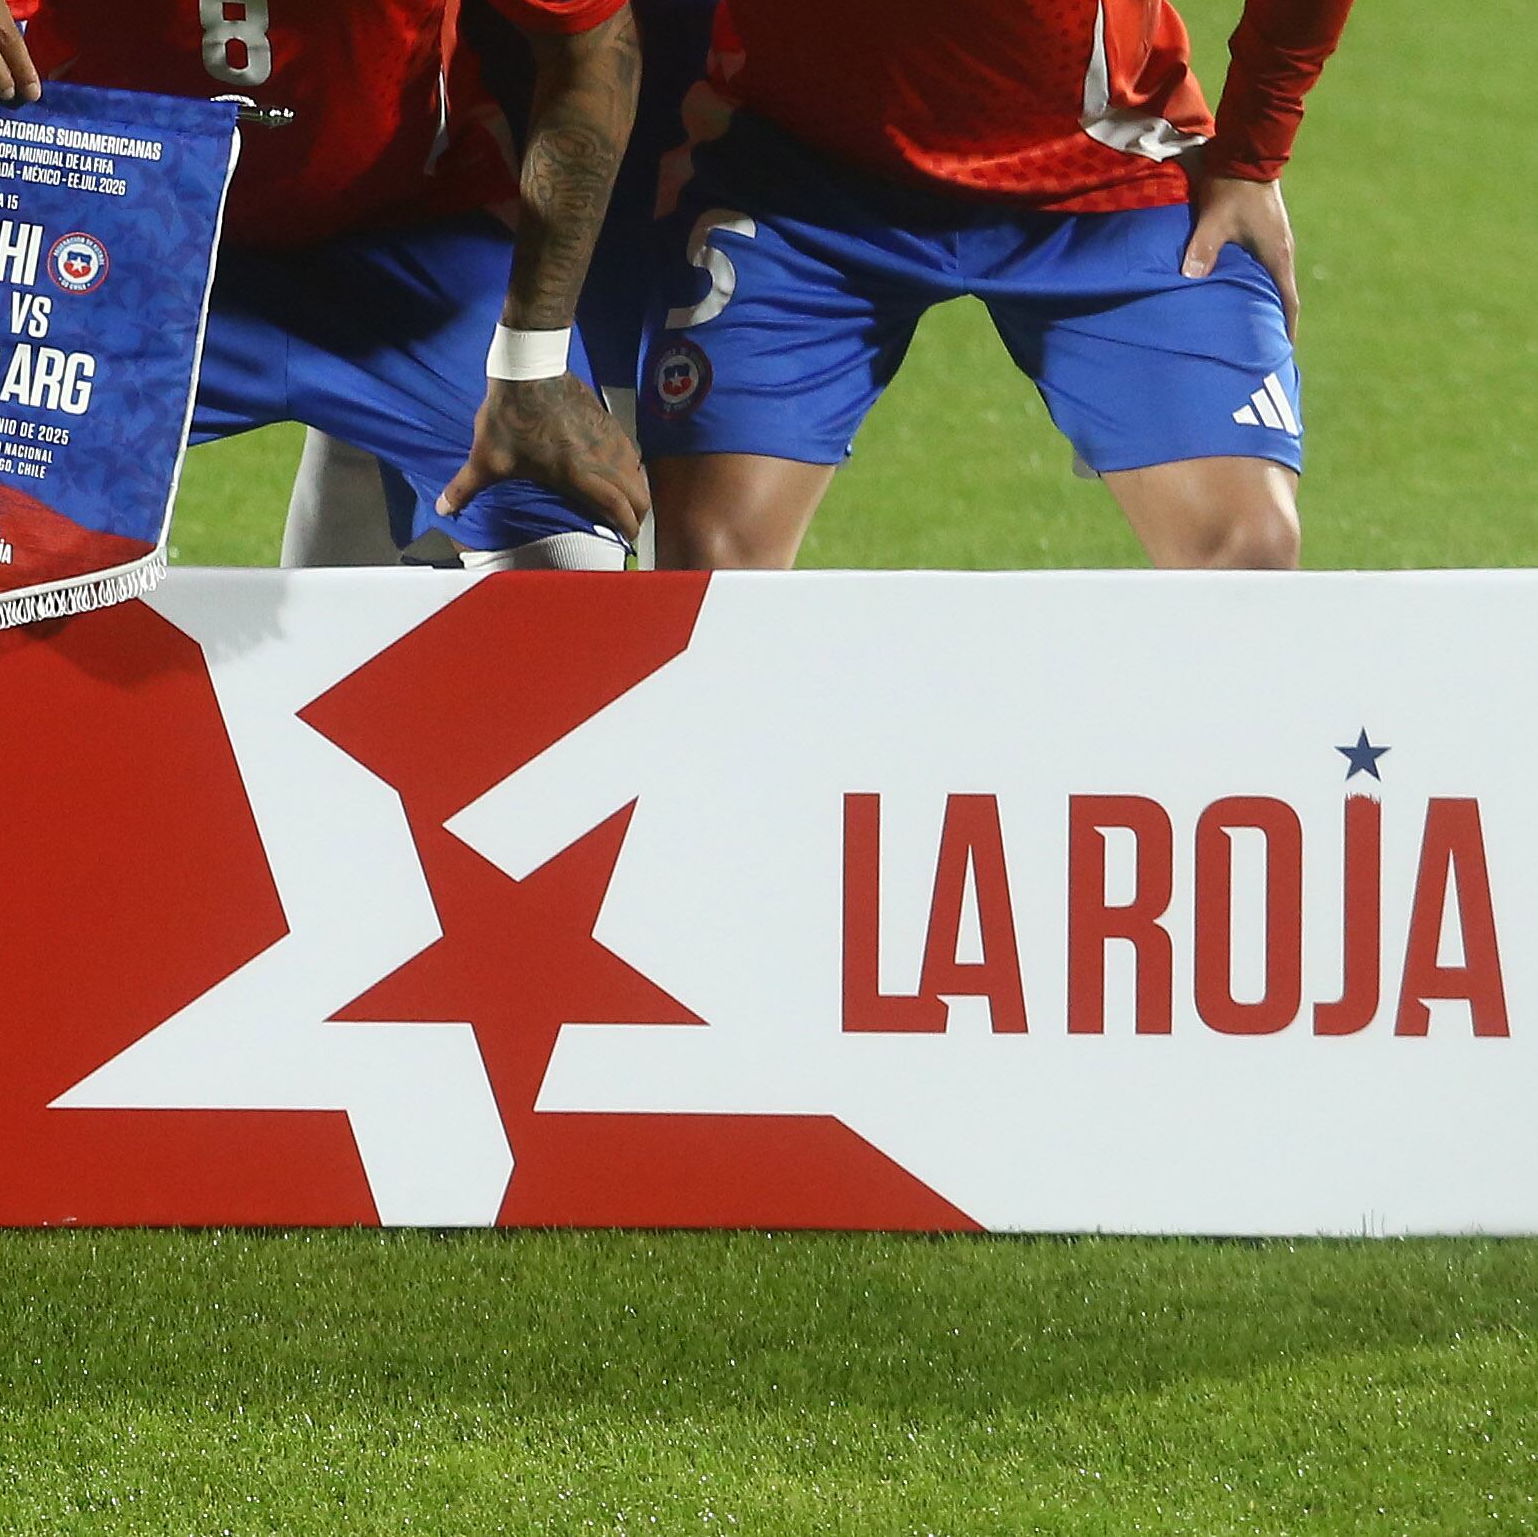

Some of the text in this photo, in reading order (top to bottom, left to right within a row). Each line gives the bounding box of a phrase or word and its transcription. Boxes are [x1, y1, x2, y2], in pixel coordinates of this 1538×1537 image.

[56, 128, 163, 161] SUDAMERICANAS
[19, 146, 64, 168] MUNDIAL
[66, 154, 80, 170] DE
[80, 155, 92, 172] LA
[93, 158, 114, 175] FIFA
[22, 165, 61, 186] MÉXICO
[67, 173, 97, 192] EE.UU.
[98, 177, 126, 196] 2026
[7, 194, 19, 210] 15
[665, 208, 756, 329] 5
[10, 291, 52, 338] VS
[0, 343, 95, 415] ARG
[20, 422, 36, 439] DE
[38, 425, 69, 445] 2025
[4, 442, 53, 463] NACIONAL
[17, 461, 47, 479] CHILE
[842, 792, 1511, 1038] LA ROJA
